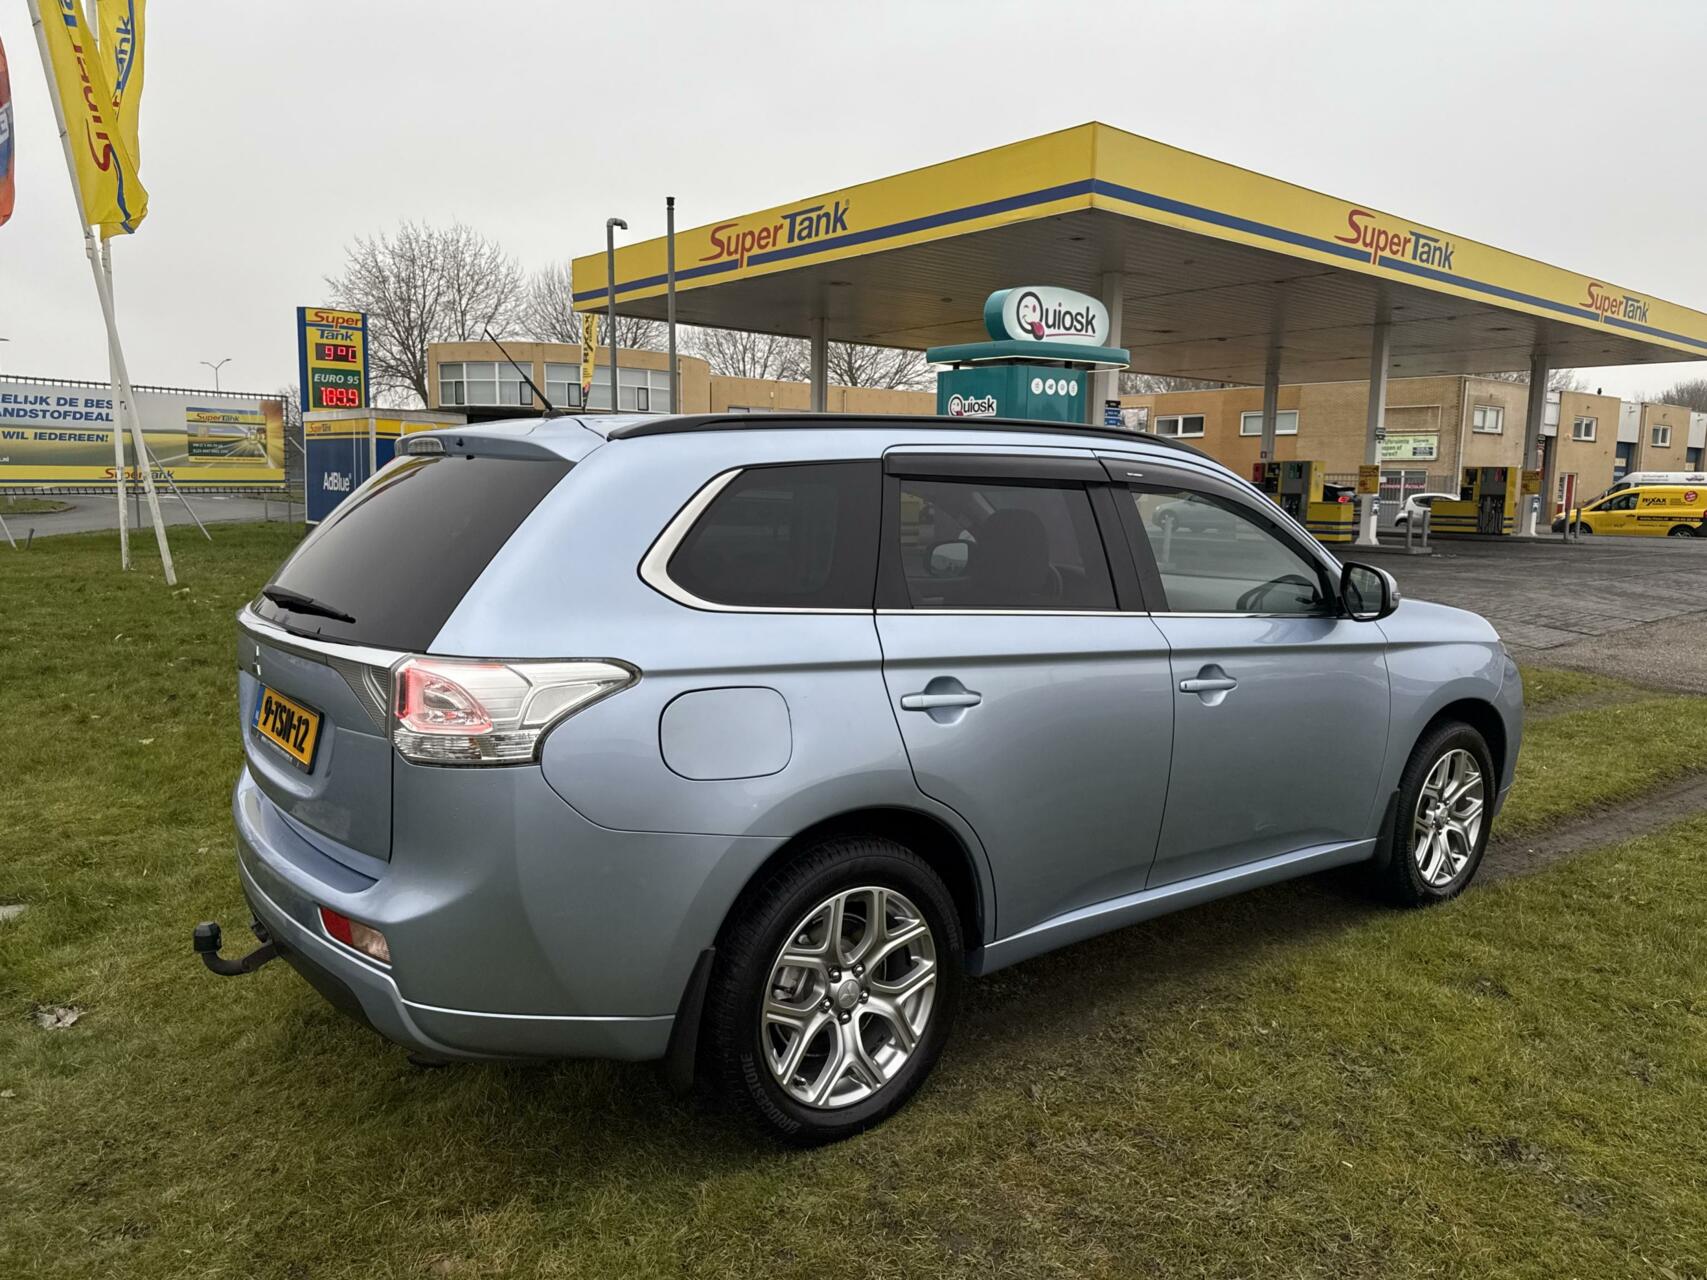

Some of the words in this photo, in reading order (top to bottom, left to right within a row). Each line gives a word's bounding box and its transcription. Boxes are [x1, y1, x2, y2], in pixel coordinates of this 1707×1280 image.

[1334, 209, 1454, 270] SuperTank
[1579, 282, 1649, 323] SuperTank
[306, 311, 361, 328] Super
[1016, 291, 1096, 341] Quiosk
[316, 328, 354, 341] Tank
[314, 373, 344, 383] EURO
[347, 375, 360, 384] 95
[56, 397, 79, 407] DE
[84, 398, 118, 410] BES
[320, 387, 359, 407] 189.9
[949, 395, 995, 416] Quiosk
[0, 407, 114, 422] NDSTOFDEAL
[2, 431, 29, 440] WIL
[34, 432, 109, 443] IEDEREEN!
[323, 471, 351, 491] AdBlue
[261, 695, 310, 754] 9-TSN-12
